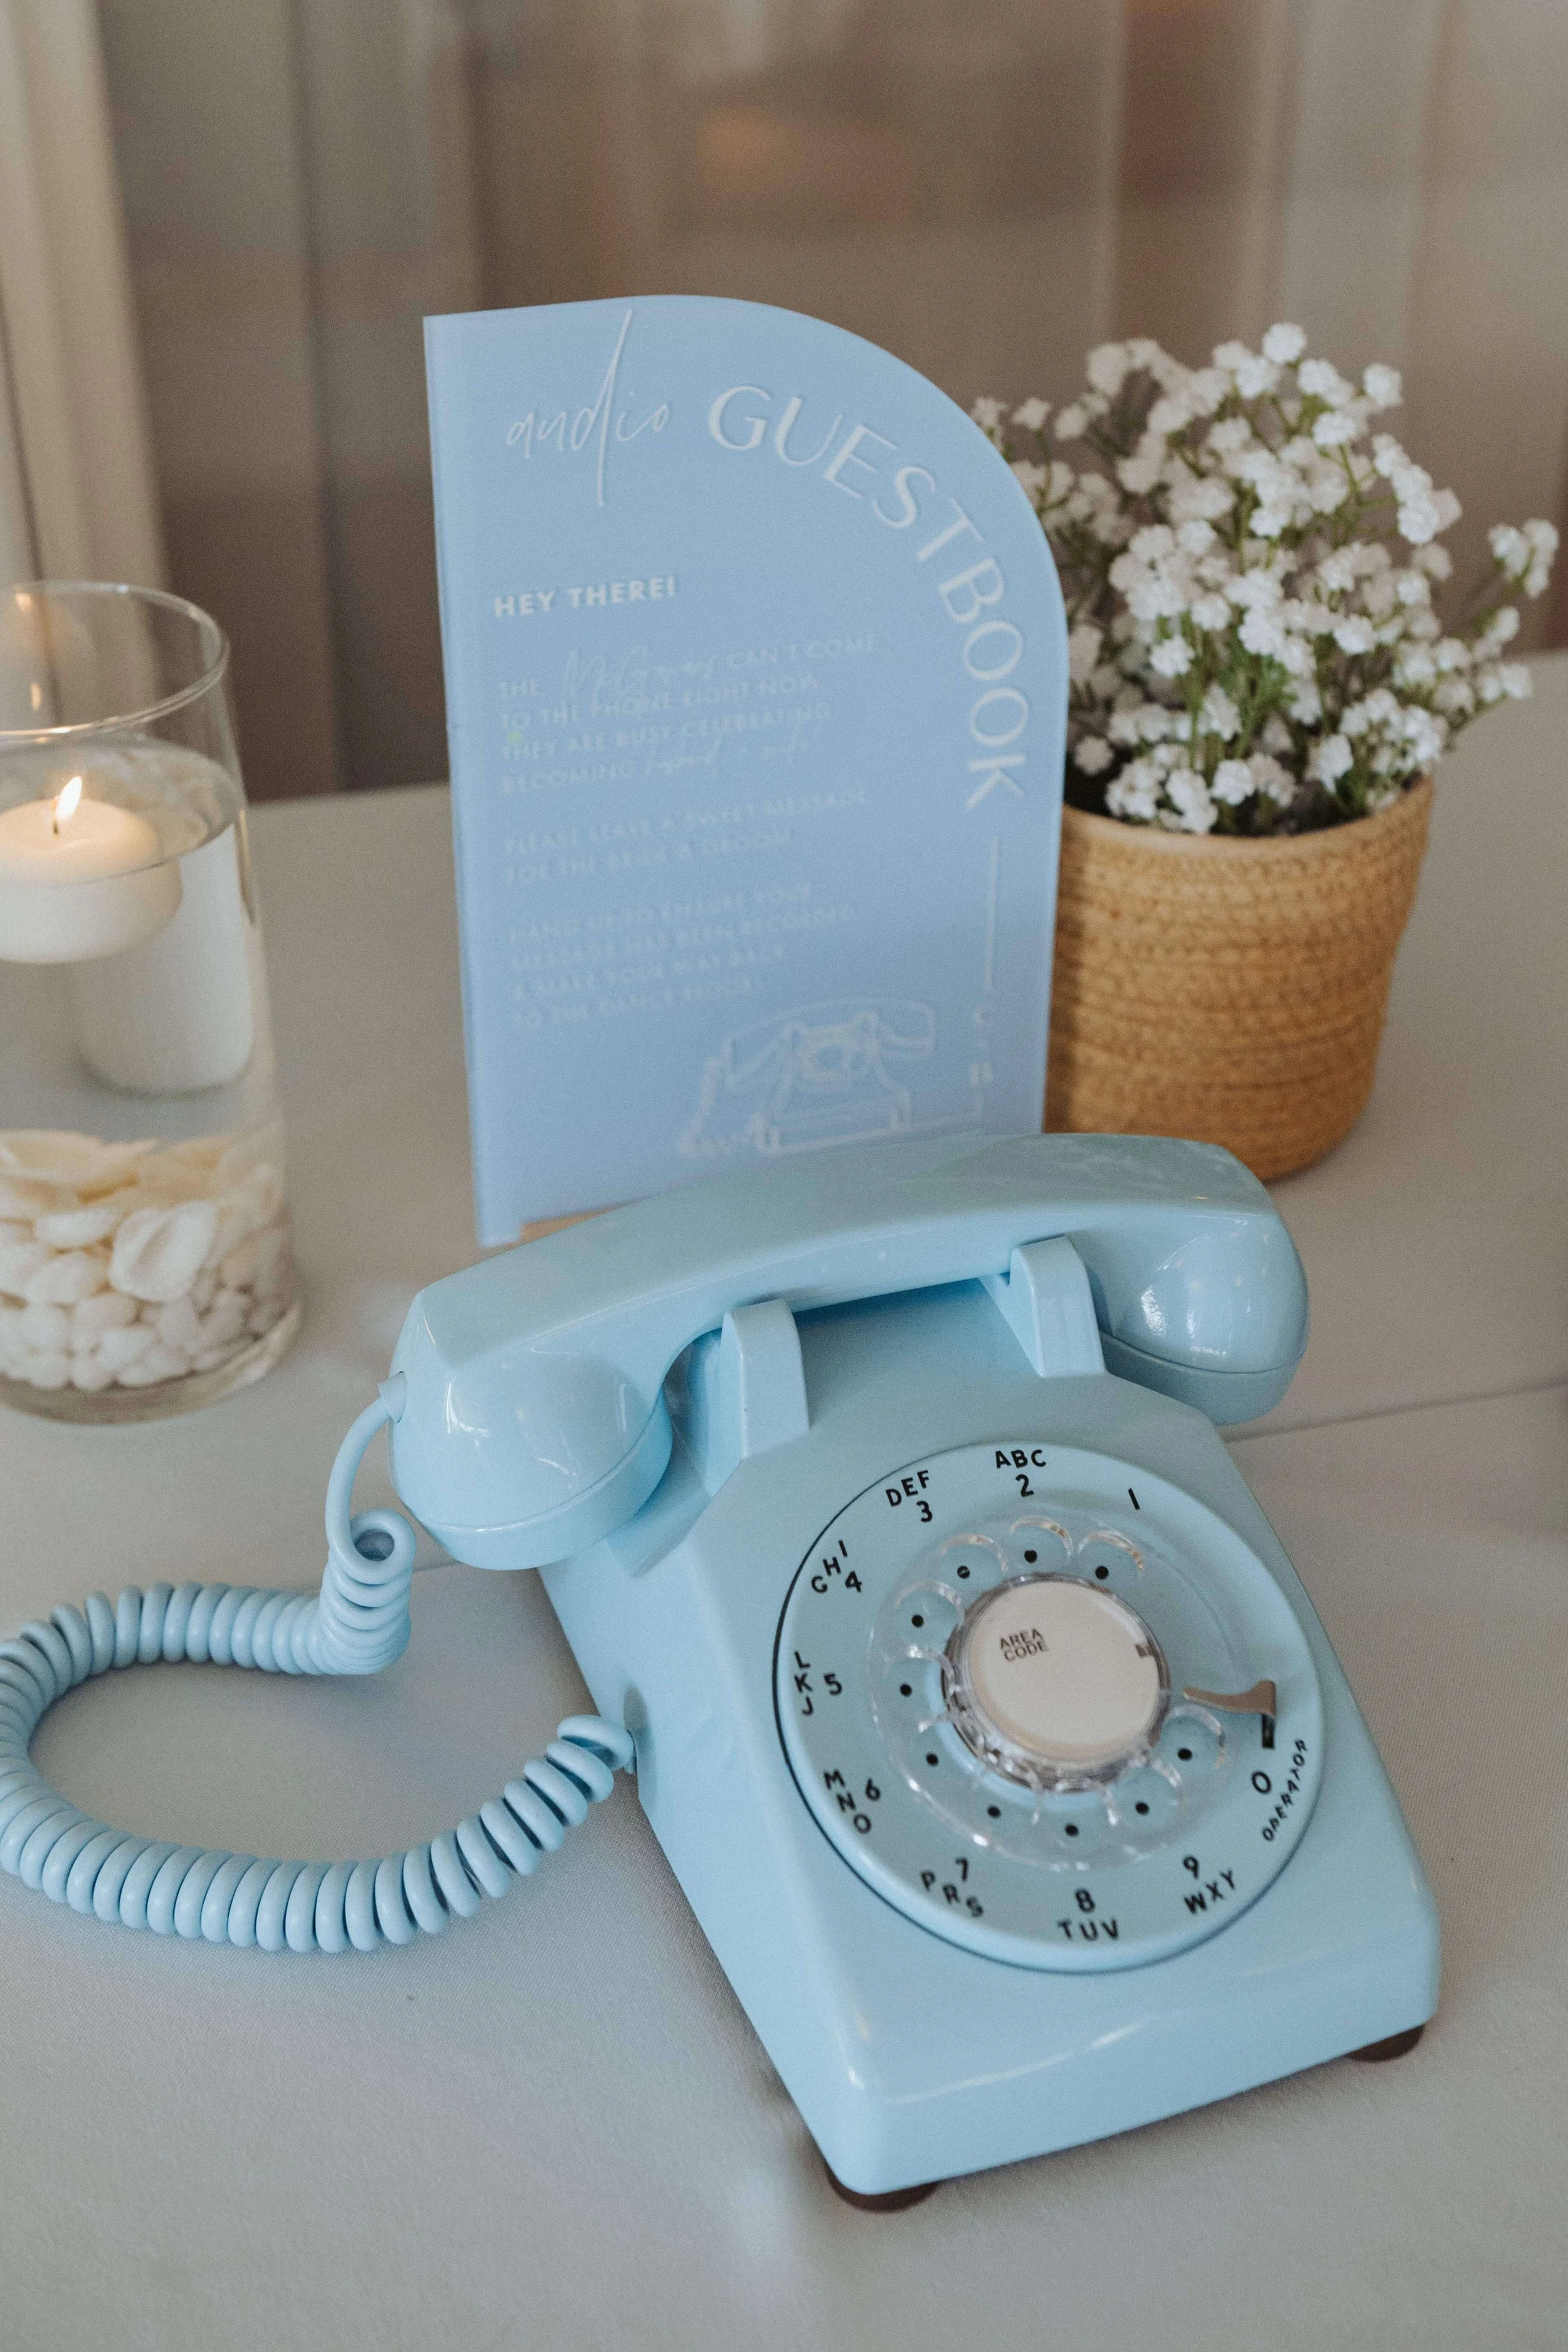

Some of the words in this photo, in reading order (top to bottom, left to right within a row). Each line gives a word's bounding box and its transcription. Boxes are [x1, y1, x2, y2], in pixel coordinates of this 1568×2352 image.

[507, 307, 670, 506] audio
[494, 591, 555, 617] HEY
[569, 576, 675, 608] THERE!
[995, 1449, 1047, 1469] ABC
[886, 1470, 930, 1507] DEF
[1015, 1474, 1034, 1497] 2
[916, 1500, 933, 1522] 3
[811, 1539, 849, 1594] GHI
[844, 1571, 862, 1593] 4
[1000, 1629, 1046, 1650] AREA
[1004, 1641, 1048, 1662] CODE
[824, 1673, 842, 1696] 5
[866, 1777, 880, 1801] 6
[1262, 1739, 1308, 1841] OPERATOR
[823, 1769, 872, 1834] MNO
[955, 1857, 969, 1882] 7
[1183, 1855, 1199, 1879] 9
[921, 1869, 983, 1918] PRS
[1074, 1888, 1095, 1912] 8
[1184, 1868, 1236, 1914] WXY
[1057, 1917, 1120, 1941] TUV
